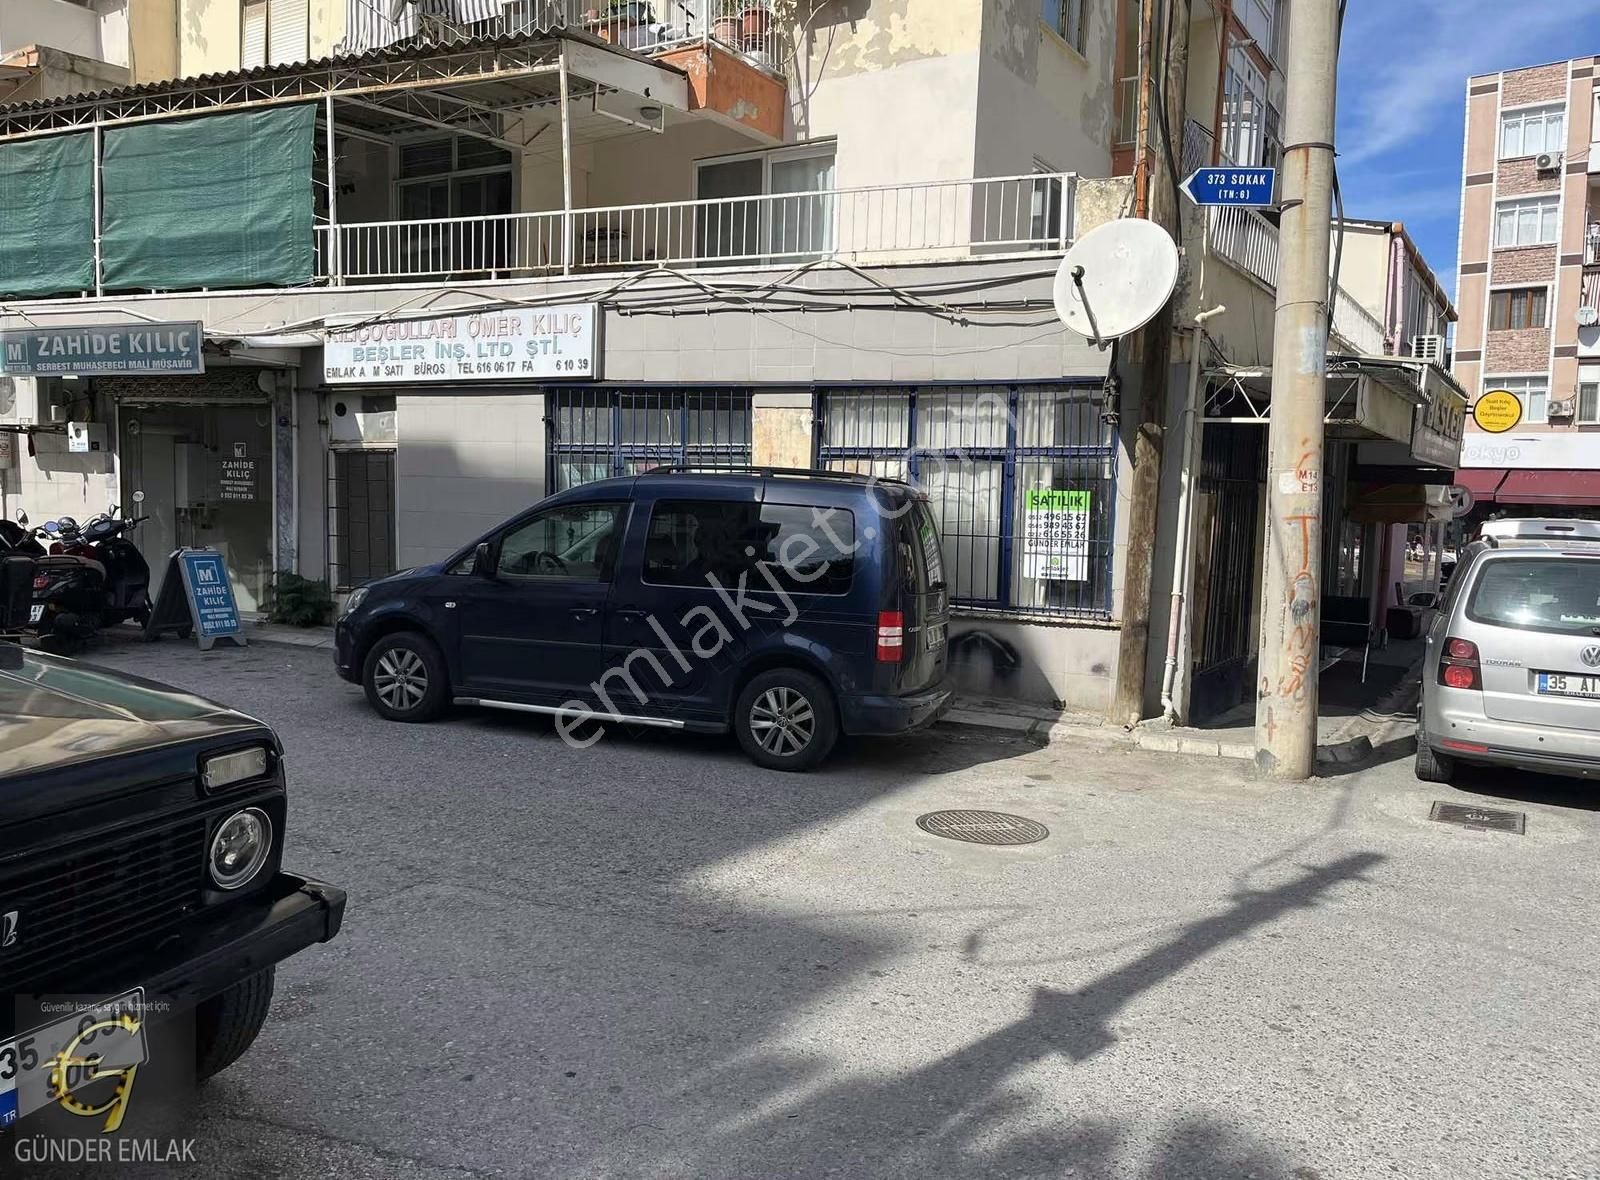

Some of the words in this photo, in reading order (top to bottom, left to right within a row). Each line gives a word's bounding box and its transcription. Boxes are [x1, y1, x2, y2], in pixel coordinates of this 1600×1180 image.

[1207, 174, 1226, 185] 373
[1231, 174, 1267, 185] SOKAK
[467, 313, 523, 339] ÖMER
[532, 312, 582, 338] KILIÇ
[37, 330, 121, 357] ZAHİDE
[128, 330, 191, 357] KILIÇ
[352, 344, 425, 364] BEŞLER
[477, 342, 513, 358] LTD
[36, 361, 71, 372] SERBEST
[72, 359, 127, 371] MUHASEBECİ
[128, 358, 150, 370] MALİ
[152, 357, 193, 370] MÜŞAVİR
[326, 367, 356, 378] EMLAK
[458, 362, 474, 374] TEL
[476, 361, 491, 373] 616
[494, 361, 505, 373] 06
[507, 361, 516, 373] 17
[522, 360, 534, 372] FA
[564, 359, 573, 371] 10
[578, 358, 589, 370] 39
[1032, 495, 1083, 507] SATILIK
[196, 586, 227, 596] ZAHİDE
[1548, 675, 1567, 690] 35
[3, 1109, 17, 1123] TR
